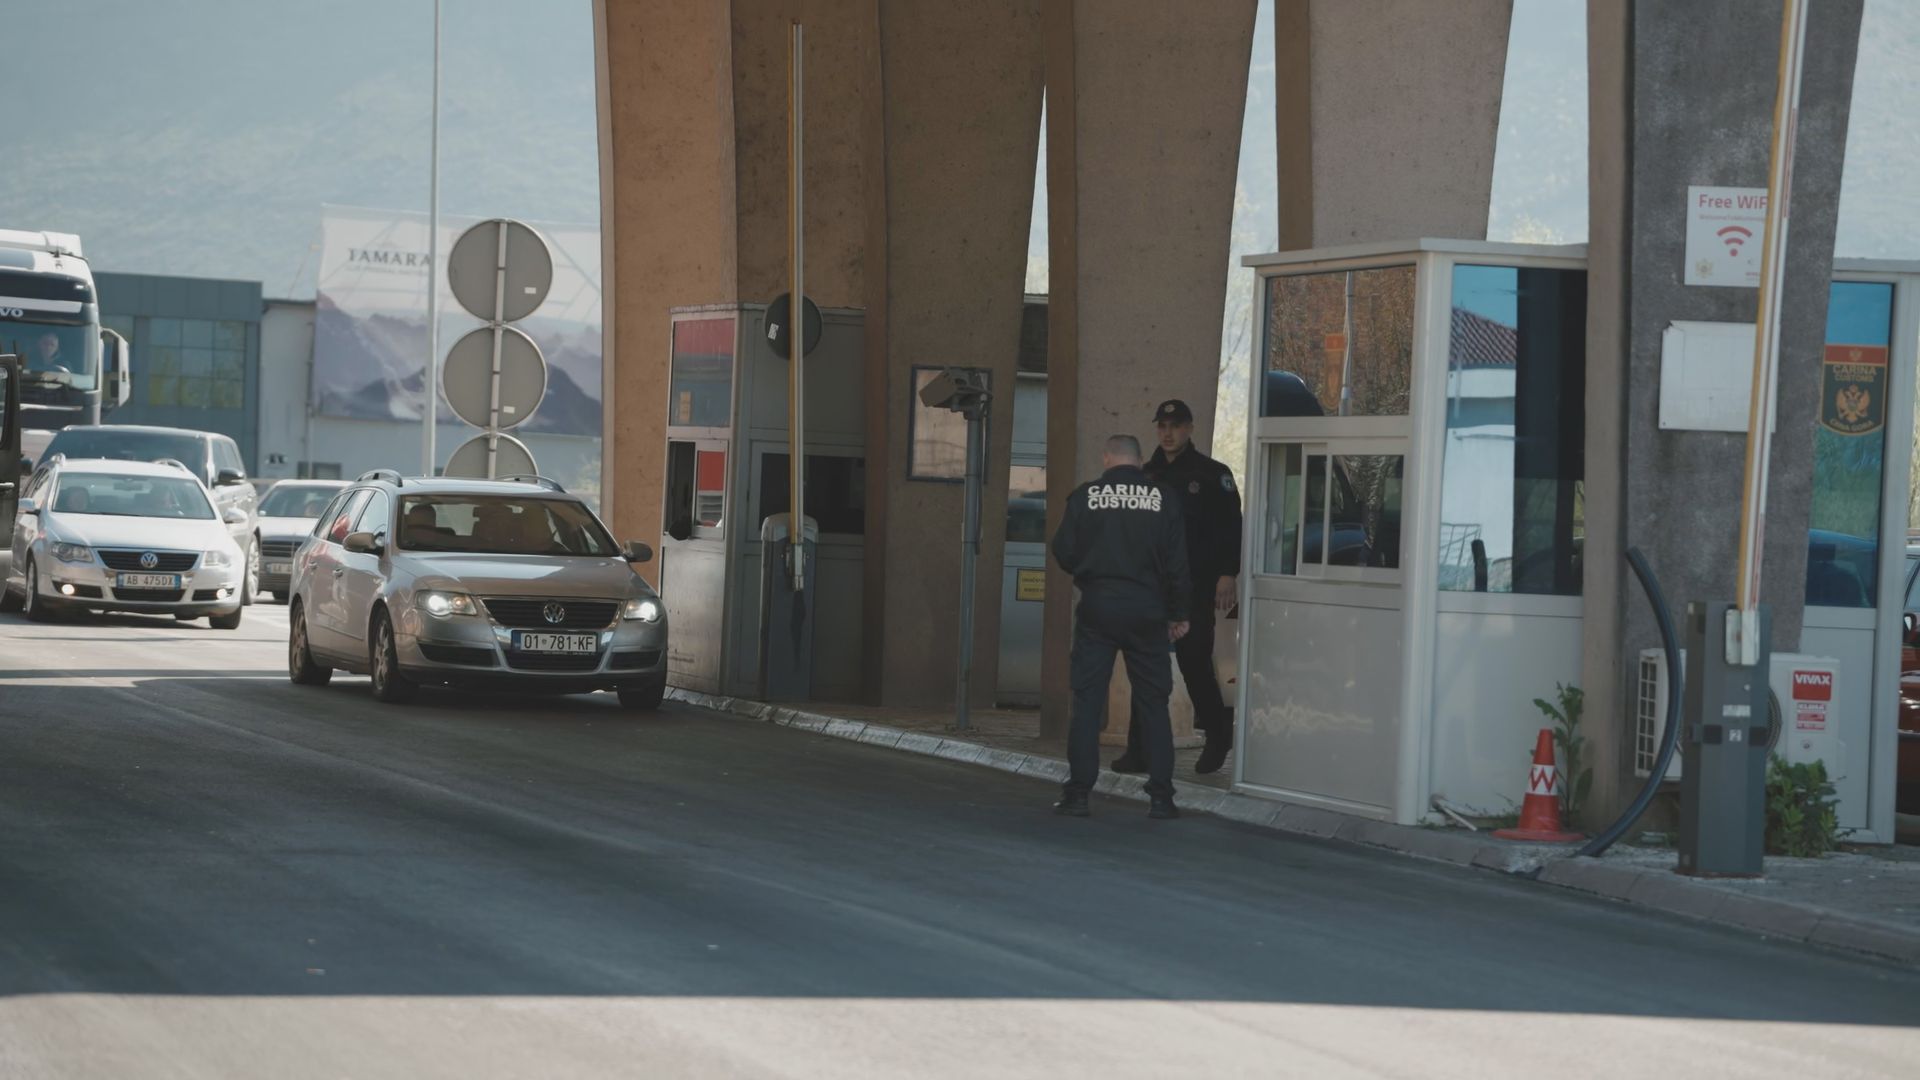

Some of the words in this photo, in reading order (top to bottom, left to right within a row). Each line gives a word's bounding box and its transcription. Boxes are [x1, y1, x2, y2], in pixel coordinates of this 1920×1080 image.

[1699, 194, 1732, 209] Free
[1737, 195, 1768, 209] WiF
[348, 249, 431, 265] TAMARA
[1833, 365, 1877, 376] CARINA
[1088, 484, 1162, 498] CARINA
[1088, 497, 1161, 512] CUSTOMS
[126, 575, 138, 585] AB
[524, 635, 539, 649] 01
[1795, 674, 1831, 685] VIVAX
